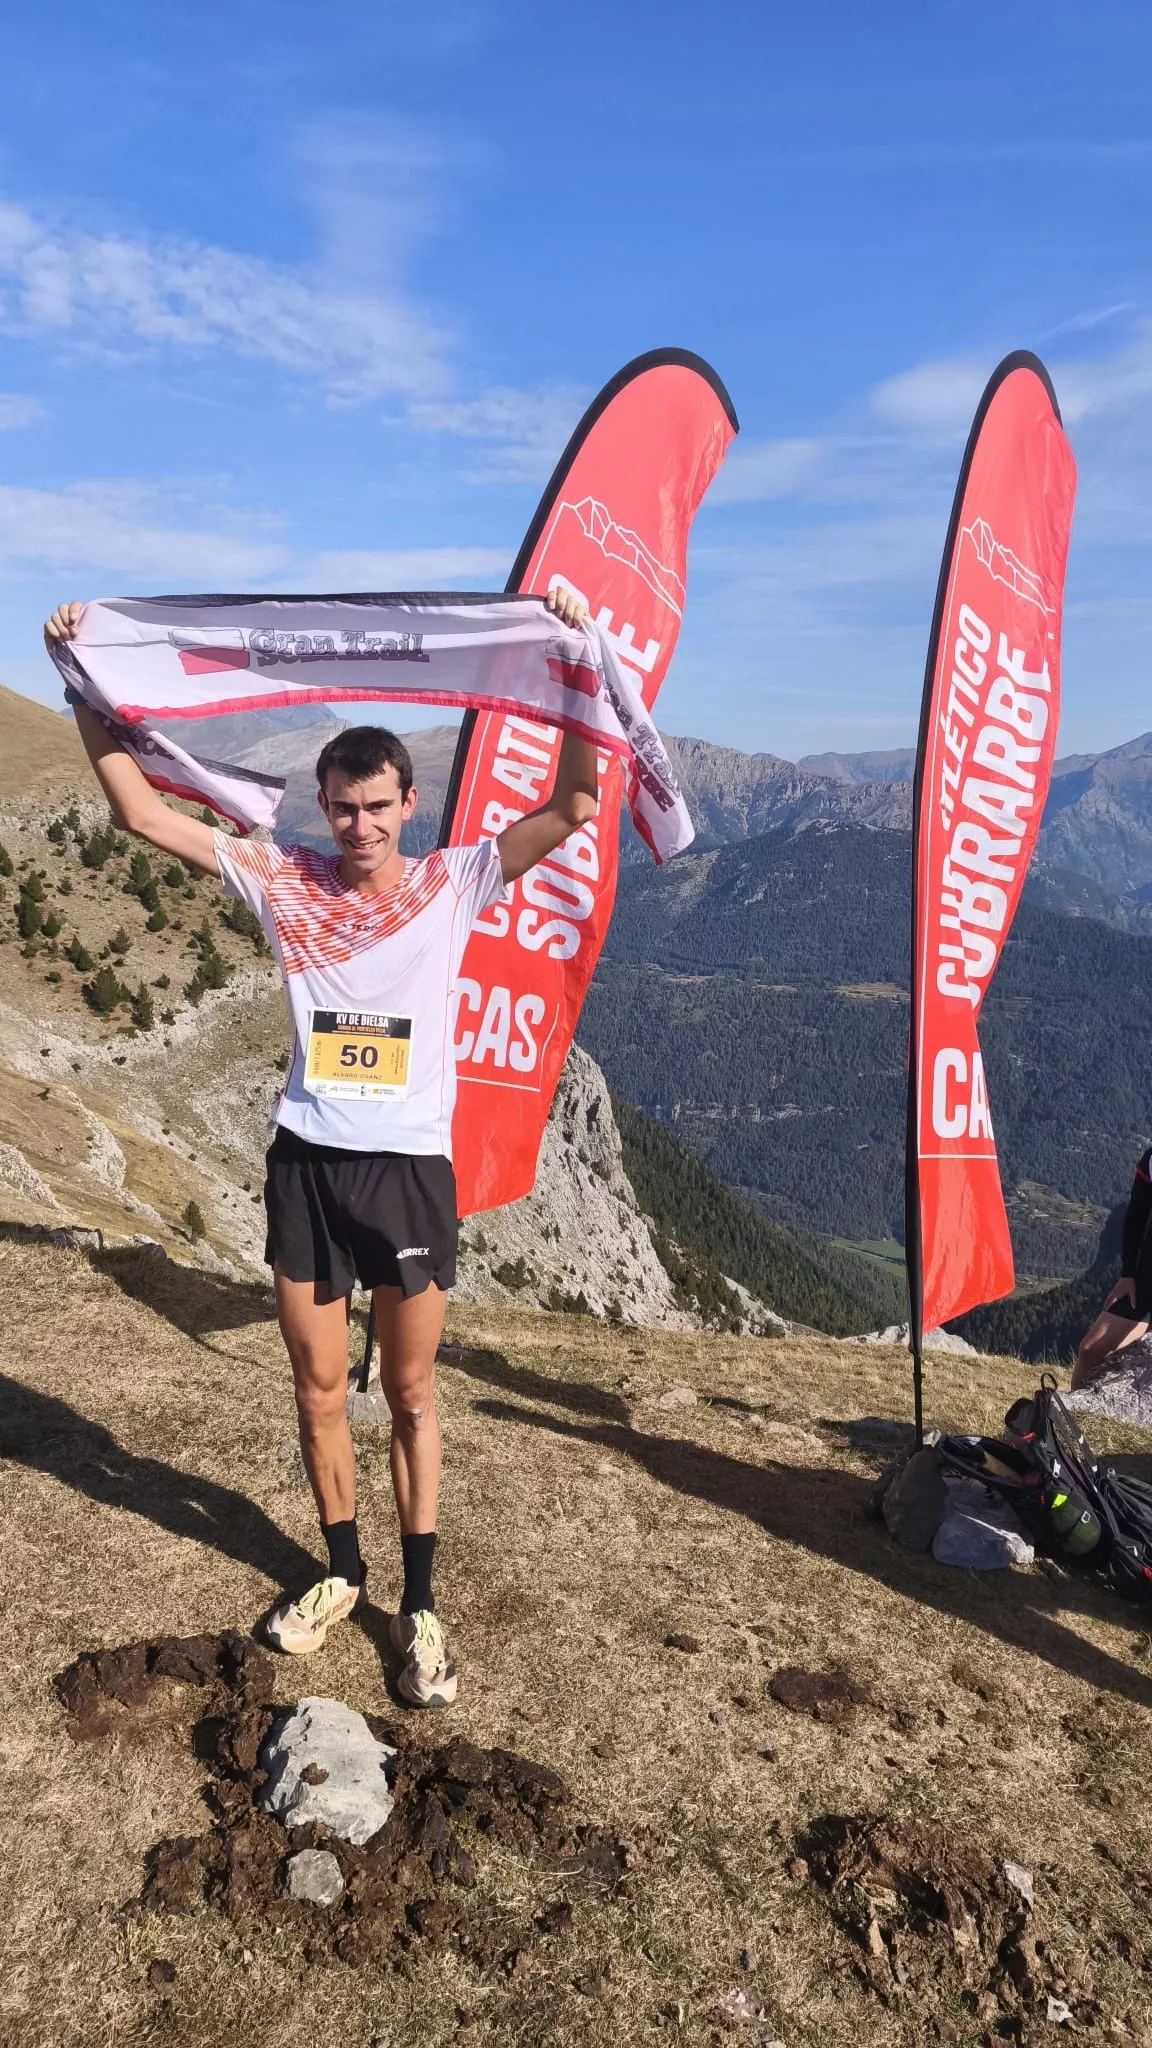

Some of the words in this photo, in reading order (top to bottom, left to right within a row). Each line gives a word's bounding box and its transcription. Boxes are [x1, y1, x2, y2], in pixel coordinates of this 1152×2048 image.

[250, 628, 338, 656] Gran
[340, 630, 424, 655] Trail
[336, 1013, 347, 1024] KV
[349, 1013, 360, 1026] DE
[361, 1015, 389, 1028] BIELSA
[454, 977, 545, 1073] CAS
[340, 1044, 379, 1069] 50
